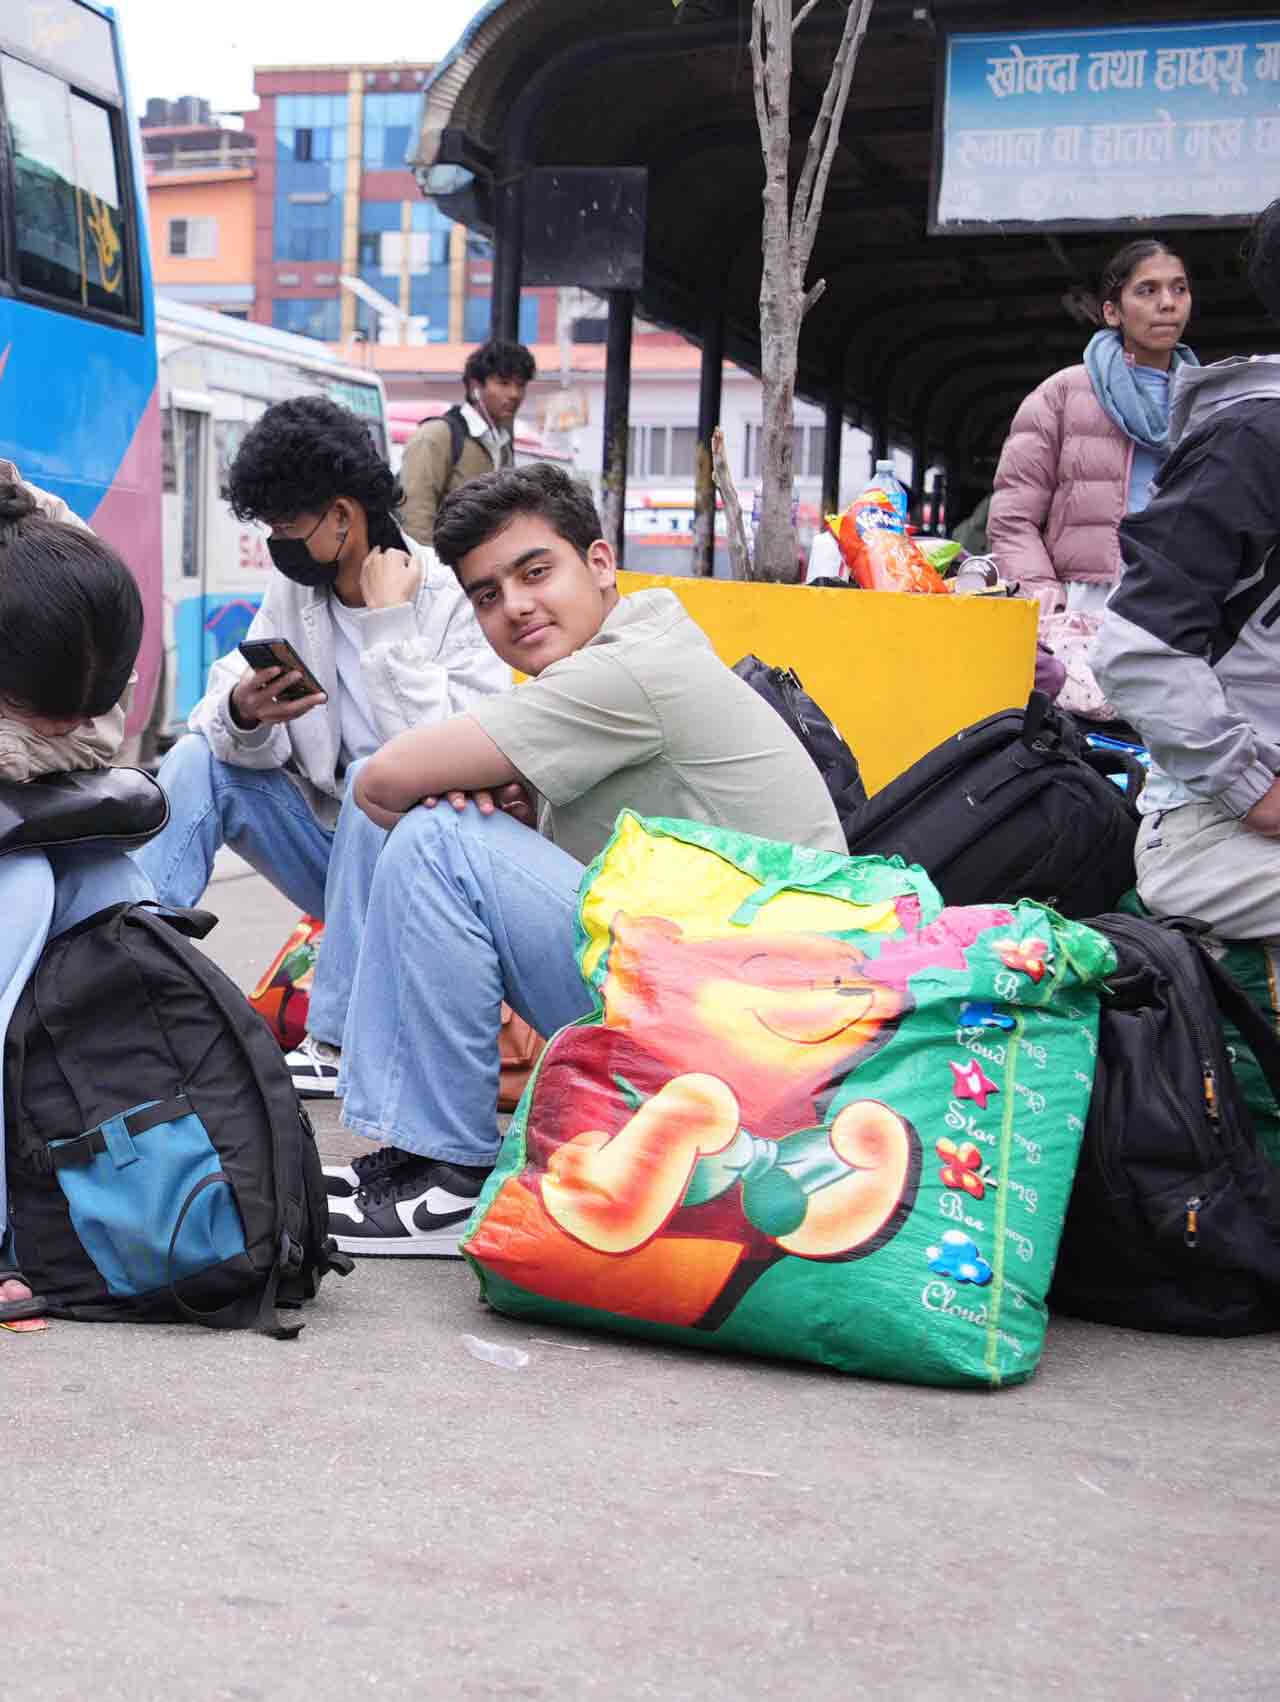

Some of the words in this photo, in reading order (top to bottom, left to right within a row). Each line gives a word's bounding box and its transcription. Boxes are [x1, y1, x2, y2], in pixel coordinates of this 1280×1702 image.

[1088, 49, 1147, 93] तथा
[943, 1099, 997, 1147] Star
[921, 1279, 988, 1327] Cloud
